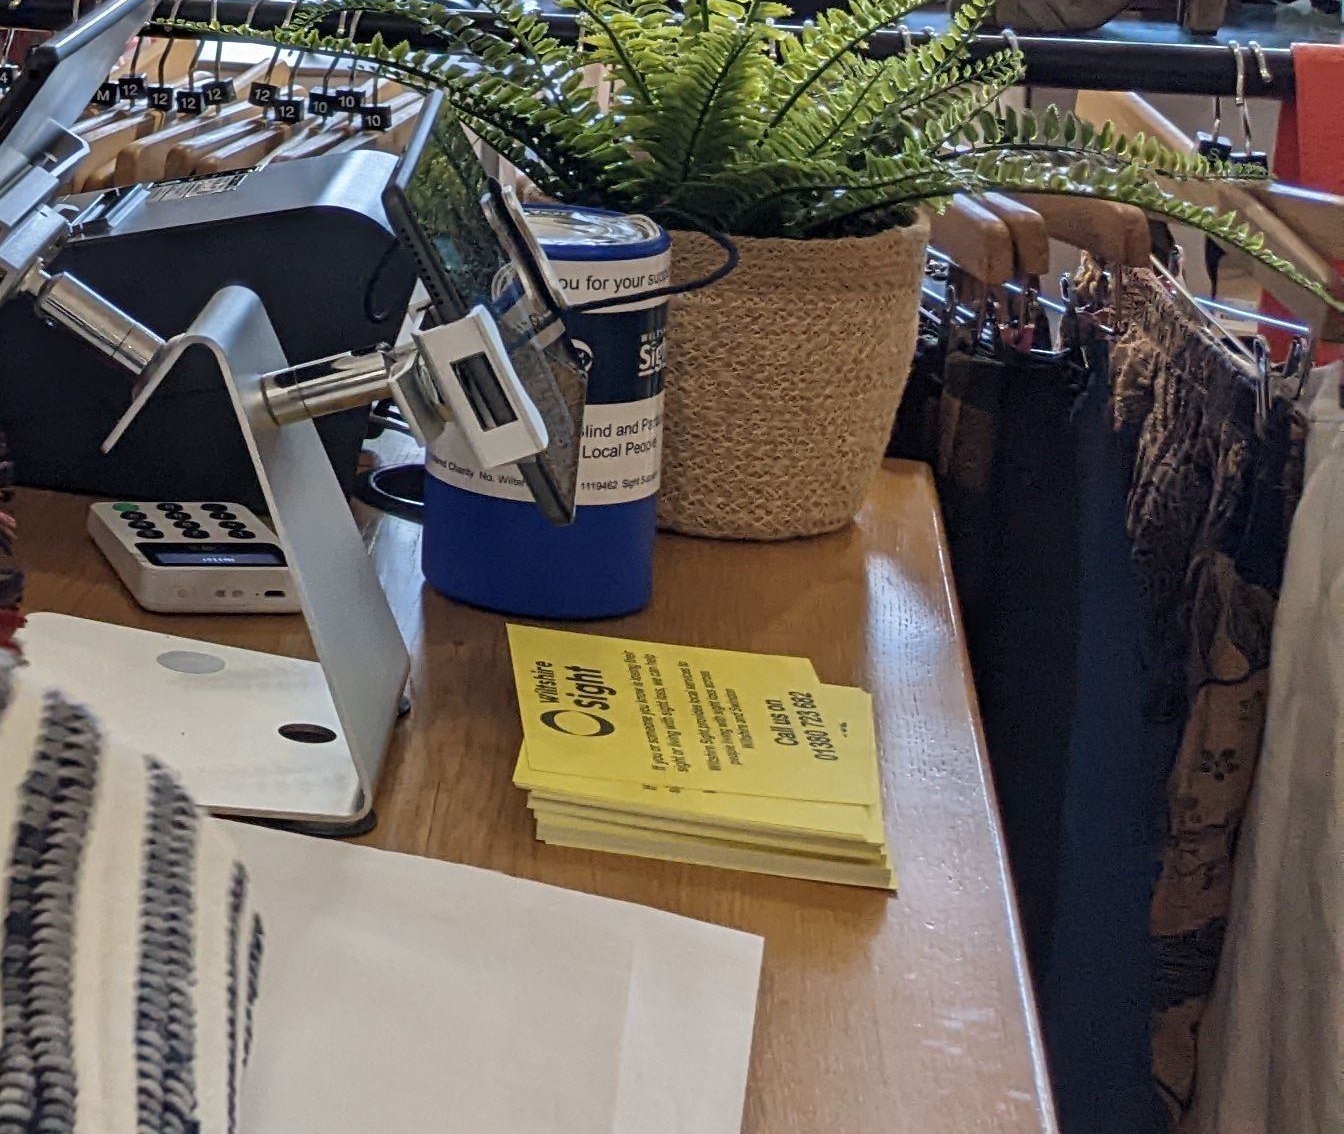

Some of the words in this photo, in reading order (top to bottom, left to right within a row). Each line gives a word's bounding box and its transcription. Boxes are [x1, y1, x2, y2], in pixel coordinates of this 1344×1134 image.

[96, 90, 110, 102] M
[122, 84, 138, 96] 12
[207, 88, 222, 101] 12
[254, 88, 270, 102] 12
[152, 93, 168, 106] 12
[181, 97, 197, 110] 12
[338, 96, 355, 108] 10
[279, 105, 295, 118] 12
[313, 101, 328, 114] 10
[365, 115, 381, 127] 10
[558, 278, 580, 291] ou
[585, 275, 609, 291] for
[613, 275, 645, 294] your
[581, 423, 612, 438] lind
[616, 422, 639, 437] and
[582, 444, 622, 459] Local
[534, 660, 560, 704] Wiltshire
[765, 698, 785, 712] on
[788, 690, 816, 709] 682
[640, 703, 656, 716] you
[771, 712, 791, 725] us
[797, 709, 825, 728] 723
[770, 725, 799, 747] Call
[807, 729, 839, 761] 01380
[651, 751, 669, 766] you
[672, 755, 691, 773] sight
